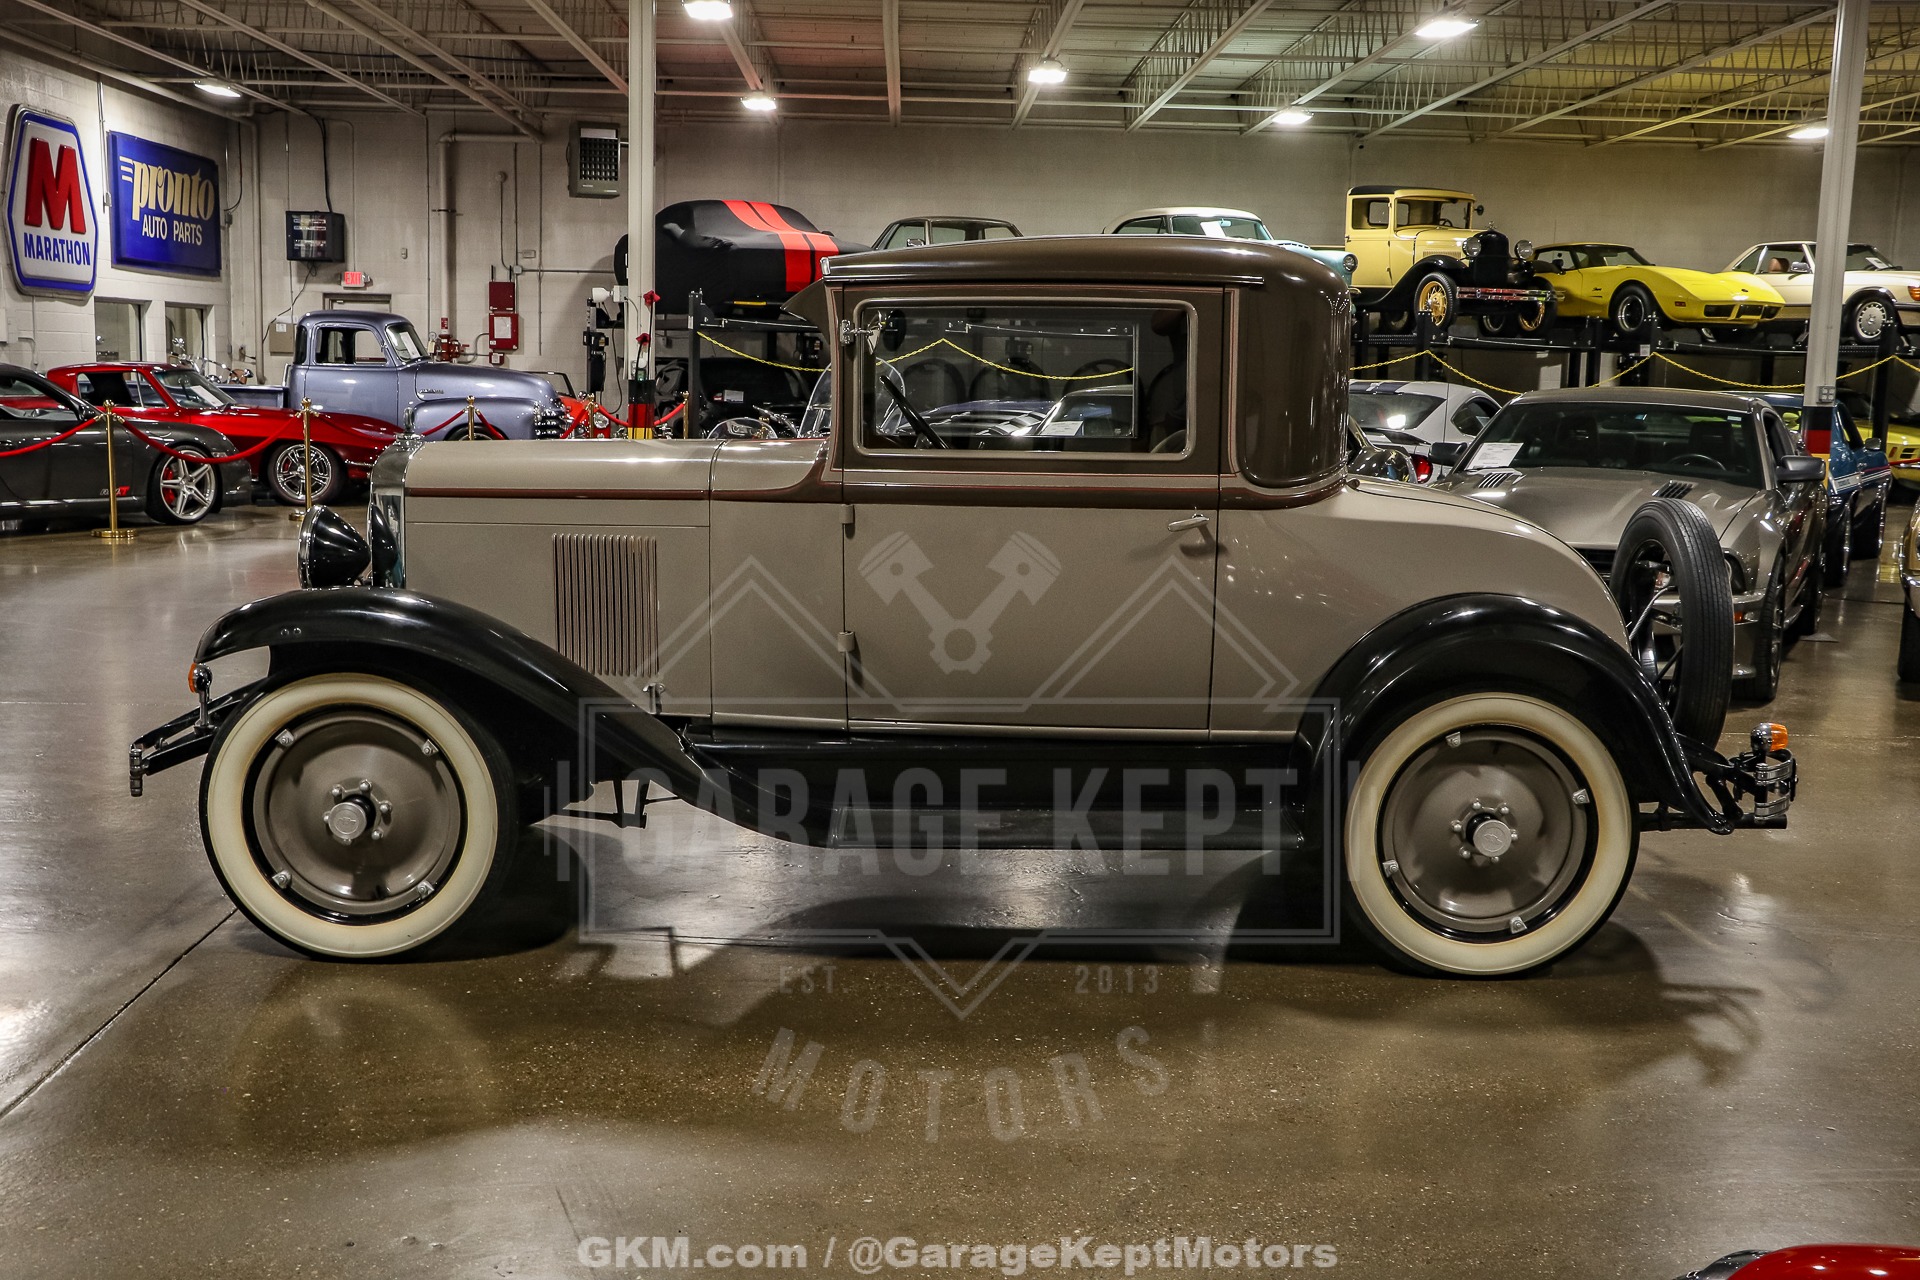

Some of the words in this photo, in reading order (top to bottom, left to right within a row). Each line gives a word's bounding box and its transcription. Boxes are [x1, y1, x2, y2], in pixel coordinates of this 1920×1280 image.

[24, 137, 86, 235] M
[132, 160, 215, 221] pronto
[142, 214, 168, 240] AUTO
[173, 220, 203, 246] PARTS
[23, 232, 91, 266] MARATHON
[344, 271, 362, 285] EXIT
